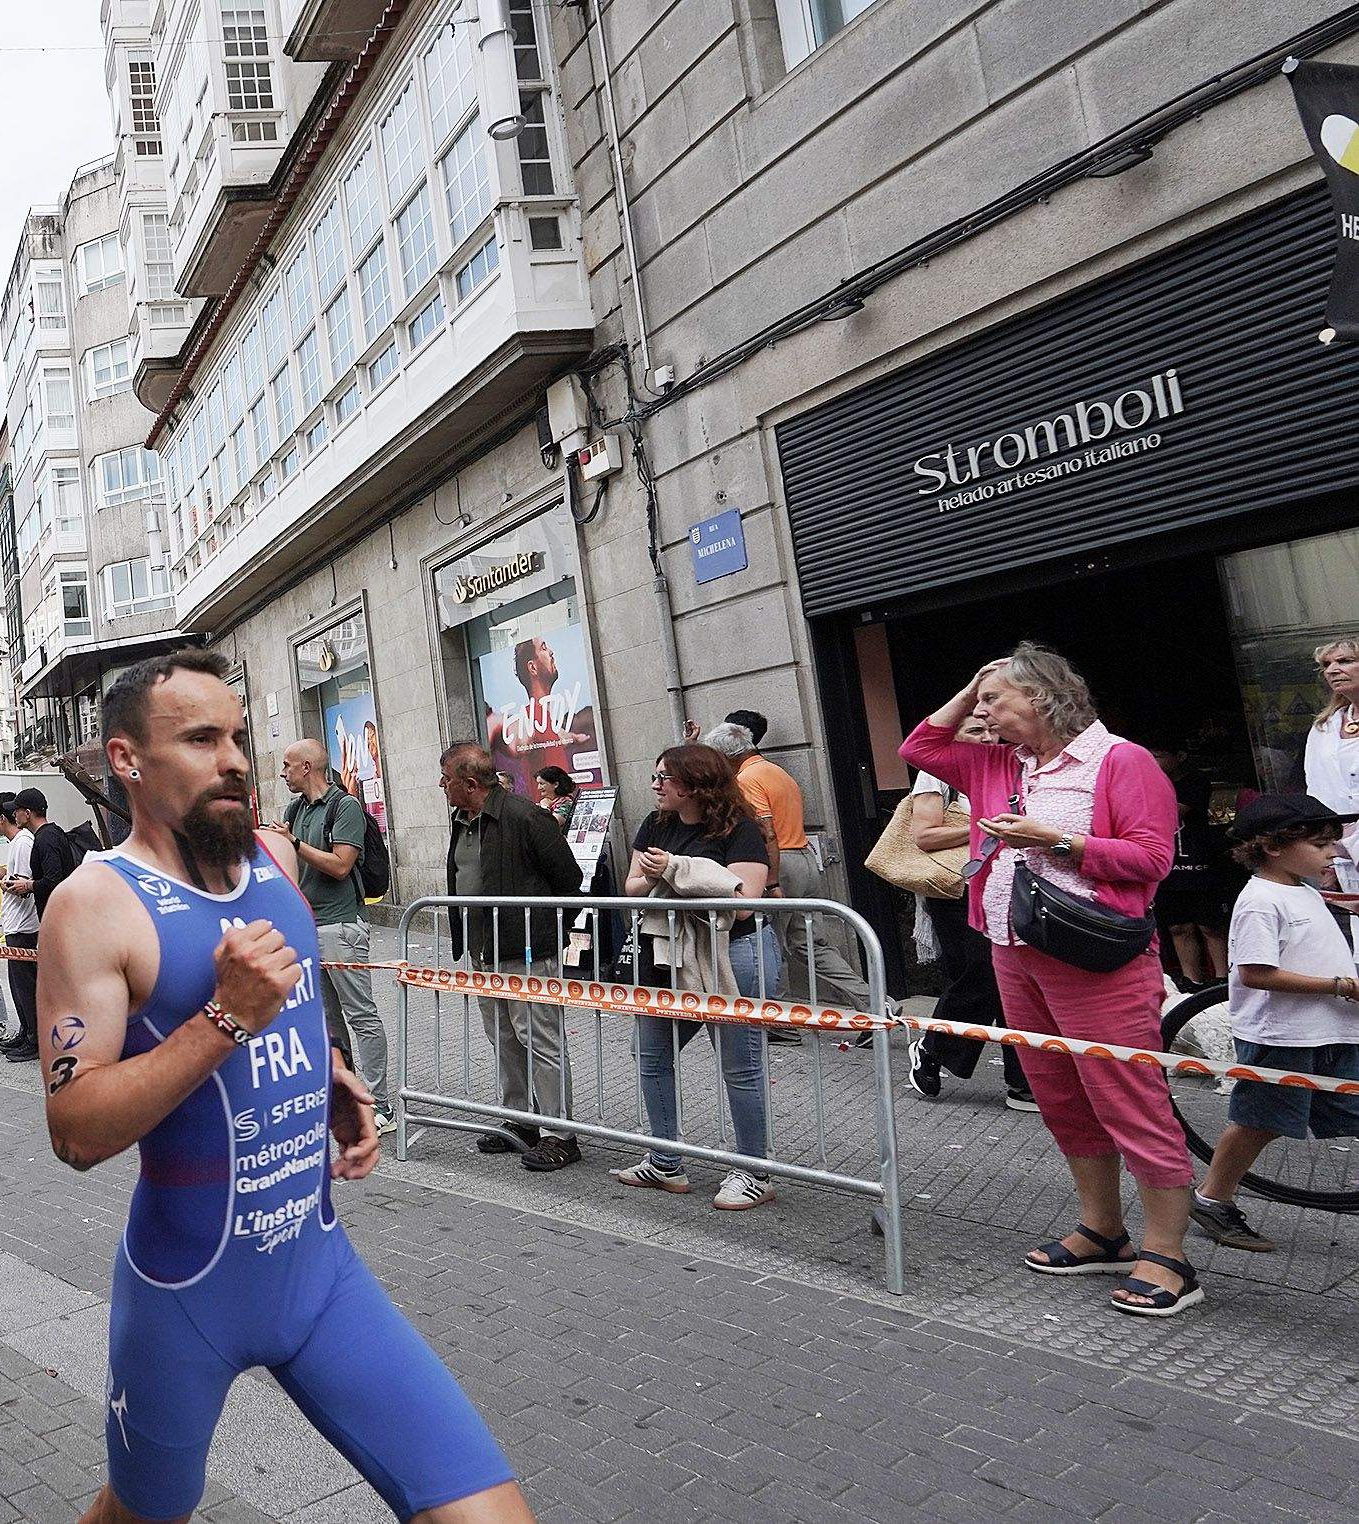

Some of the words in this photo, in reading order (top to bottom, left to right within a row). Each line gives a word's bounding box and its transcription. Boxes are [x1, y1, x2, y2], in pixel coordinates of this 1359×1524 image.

[913, 369, 1184, 495] stromboli
[937, 484, 994, 513] helado
[997, 456, 1083, 495] artesano
[1085, 433, 1162, 468] italiano
[698, 537, 736, 559] MICHELENA
[467, 551, 533, 599] Santander
[501, 680, 581, 745] ENJOY
[655, 1008, 698, 1019] PONTEVEDRA
[50, 1056, 78, 1094] 3
[248, 1026, 313, 1089] FRA
[236, 1121, 326, 1173] métropole
